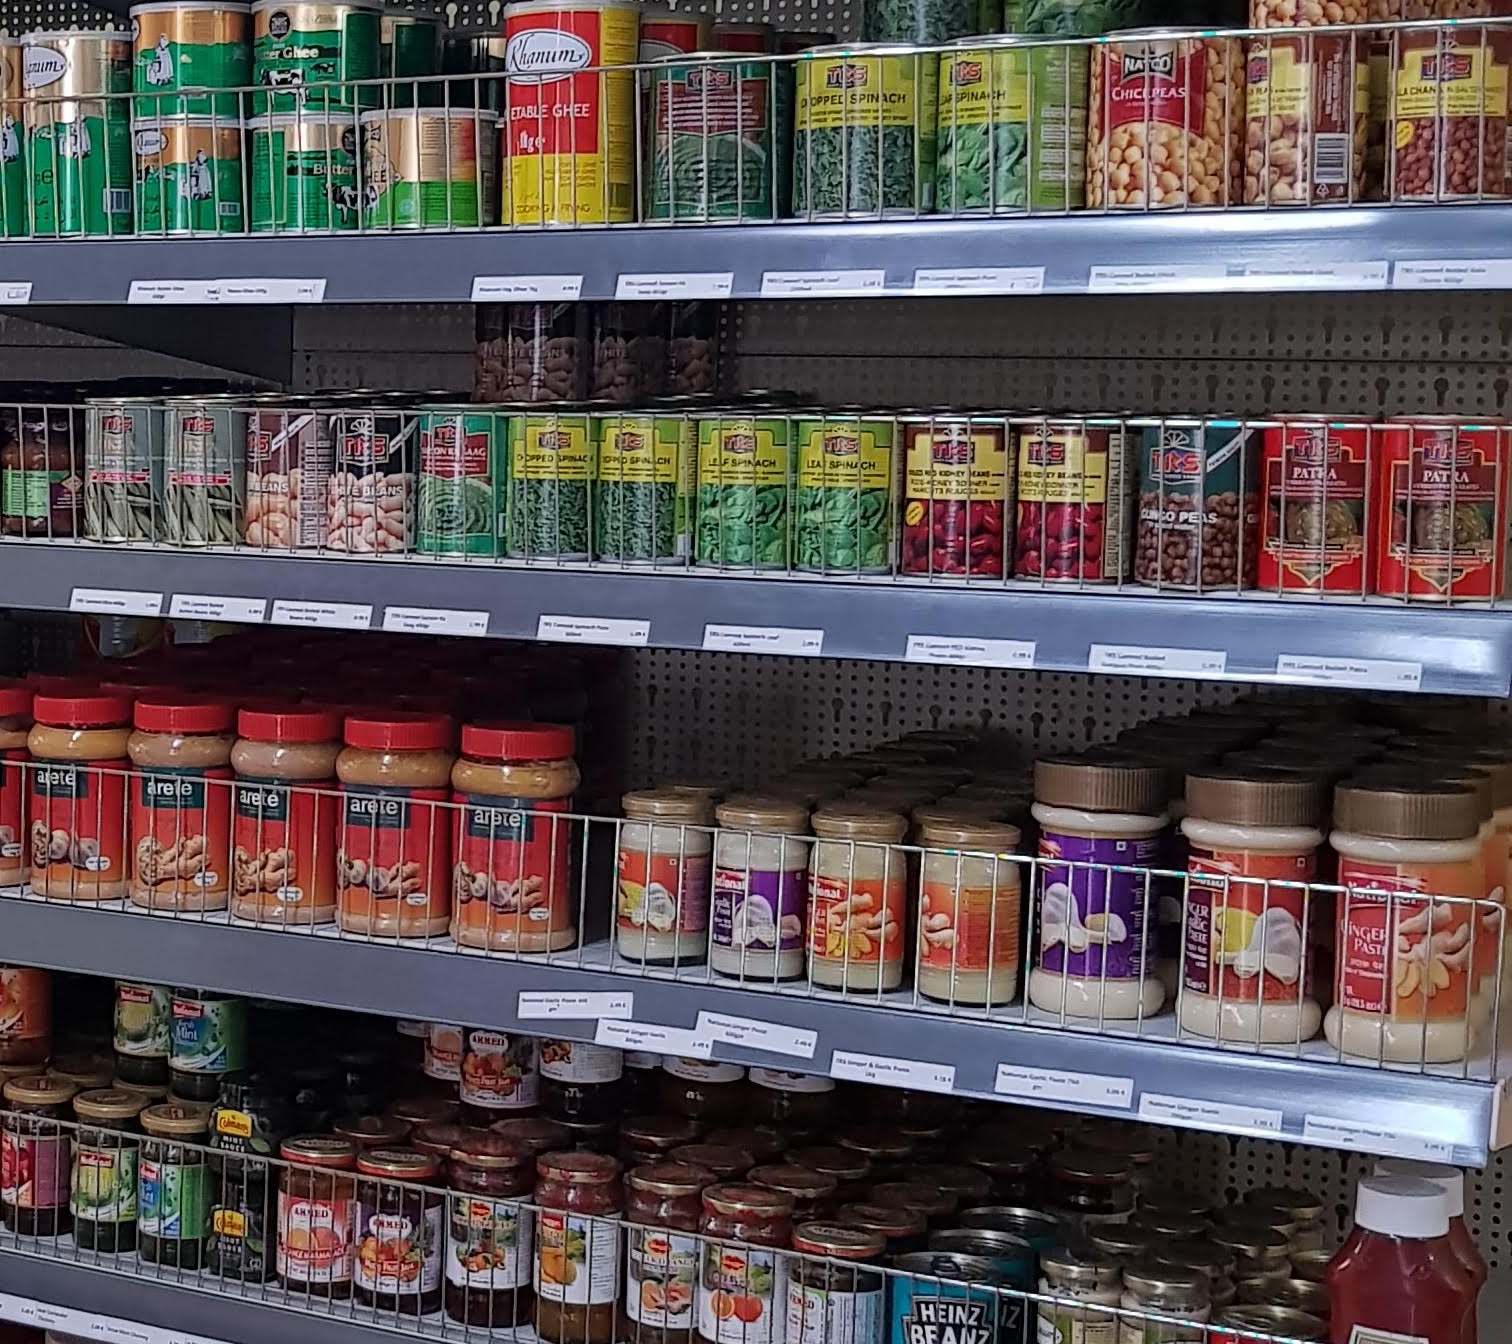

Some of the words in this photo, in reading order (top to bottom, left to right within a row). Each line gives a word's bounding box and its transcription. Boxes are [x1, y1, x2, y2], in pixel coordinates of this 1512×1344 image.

[283, 46, 321, 61] Ghee
[507, 36, 585, 75] Khanum
[1124, 55, 1175, 75] NATCO
[848, 91, 907, 107] SPINACH
[1110, 84, 1187, 104] CHICPEAS
[551, 102, 592, 120] GHEE
[343, 436, 388, 457] TRS
[1150, 450, 1202, 474] TRS
[1422, 469, 1471, 485] PATRA
[919, 1302, 981, 1327] HEINZ
